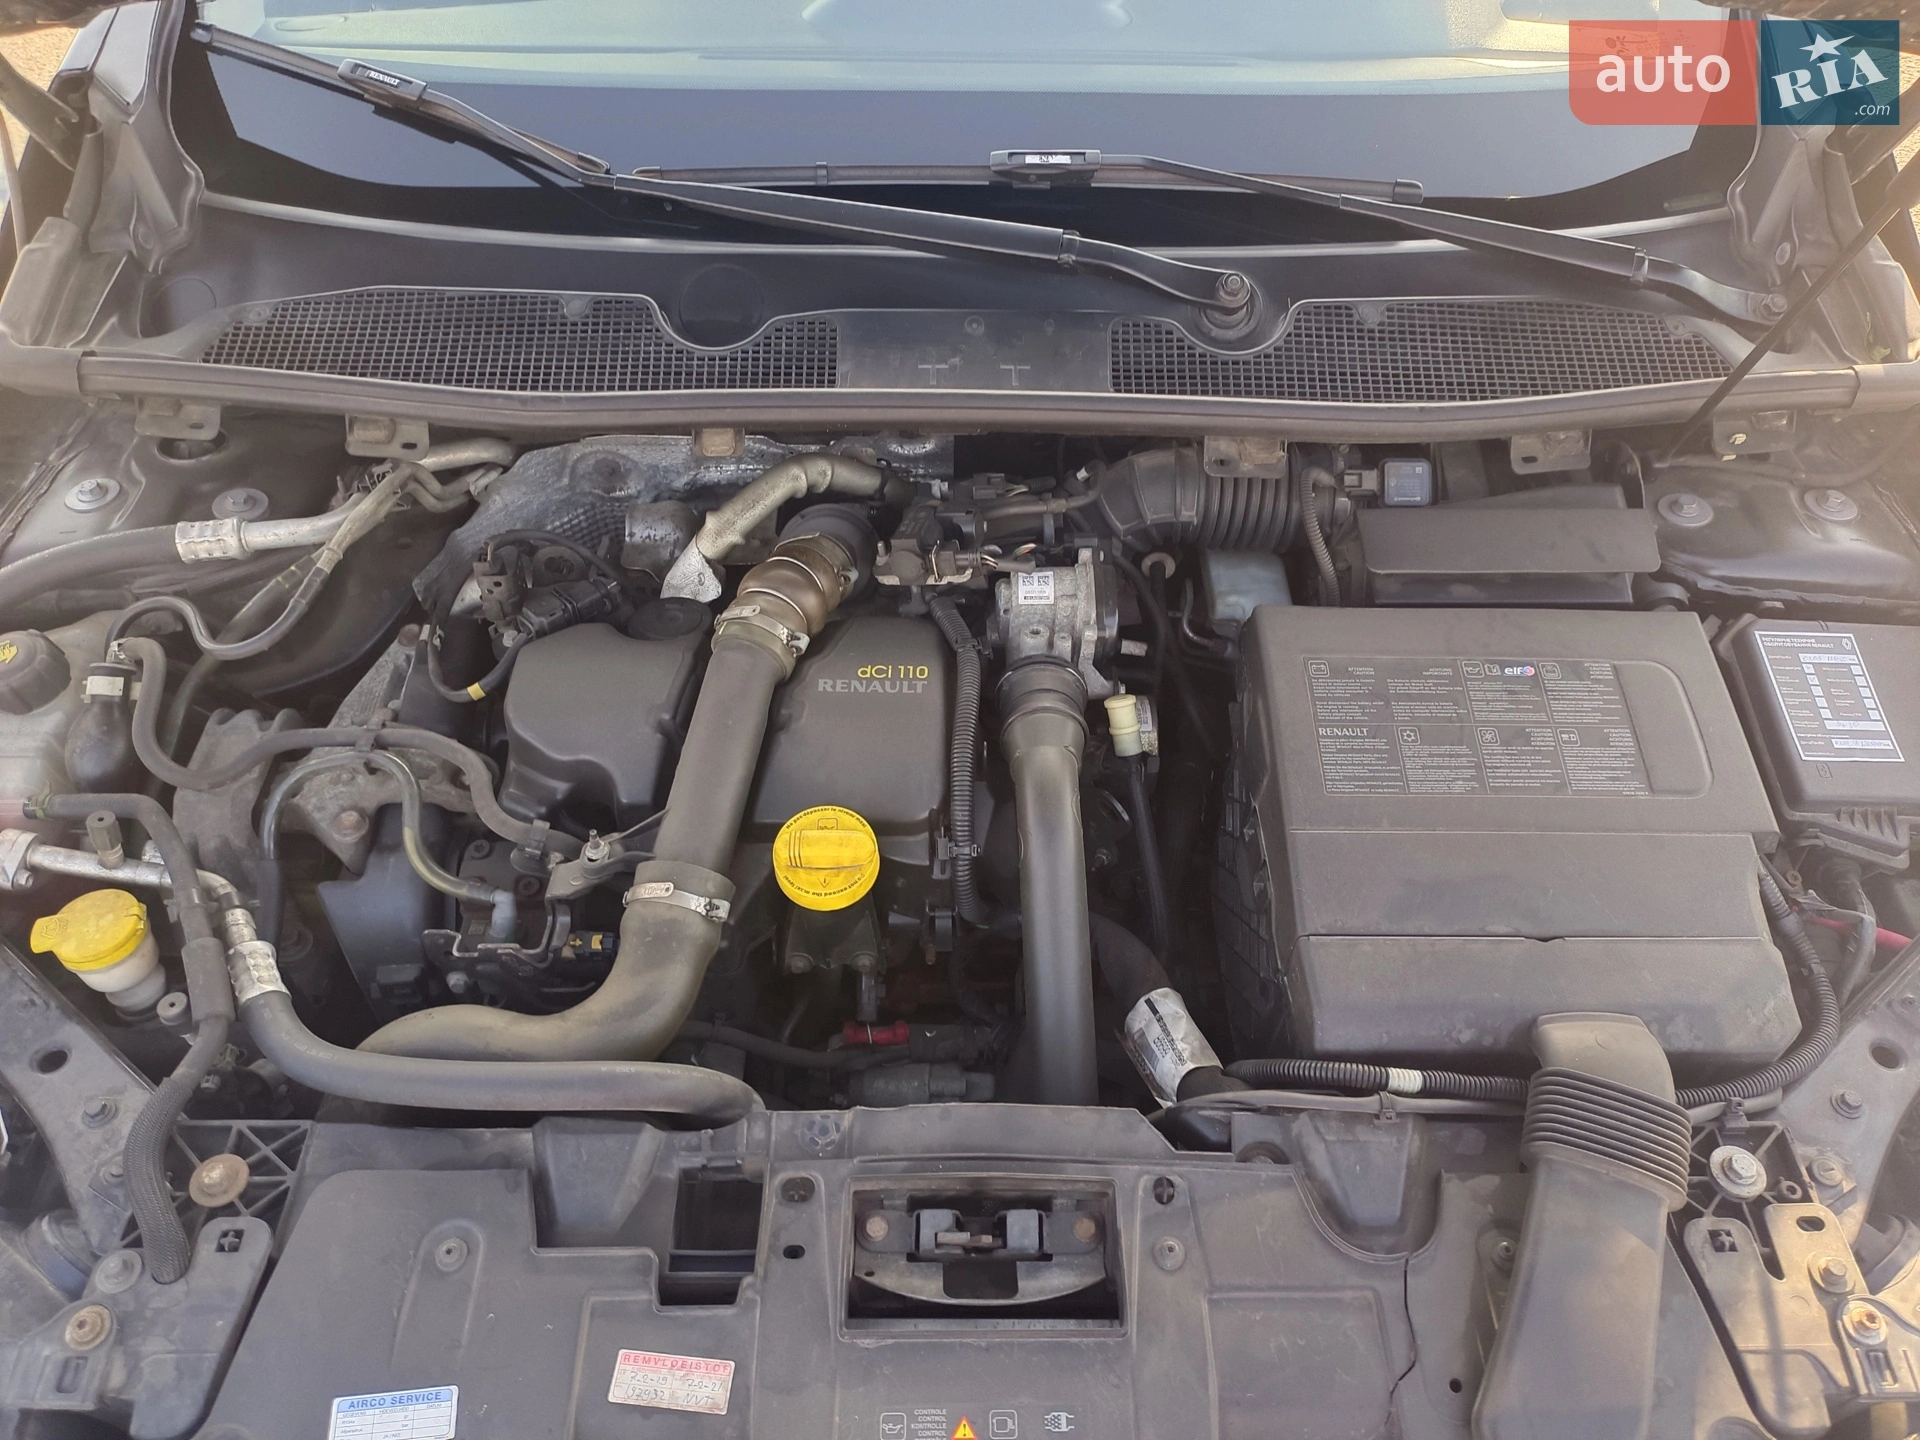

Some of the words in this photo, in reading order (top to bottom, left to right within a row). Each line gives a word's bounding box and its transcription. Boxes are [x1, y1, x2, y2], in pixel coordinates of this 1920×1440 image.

[368, 69, 401, 86] RENAULT
[857, 665, 892, 679] dCi
[899, 665, 929, 679] 110
[817, 679, 928, 694] RENAULT
[1318, 727, 1369, 736] RENAULT
[623, 1354, 731, 1372] REMVLOEISTOF
[348, 1397, 386, 1409] AIRCO
[390, 1391, 442, 1405] SERVICE
